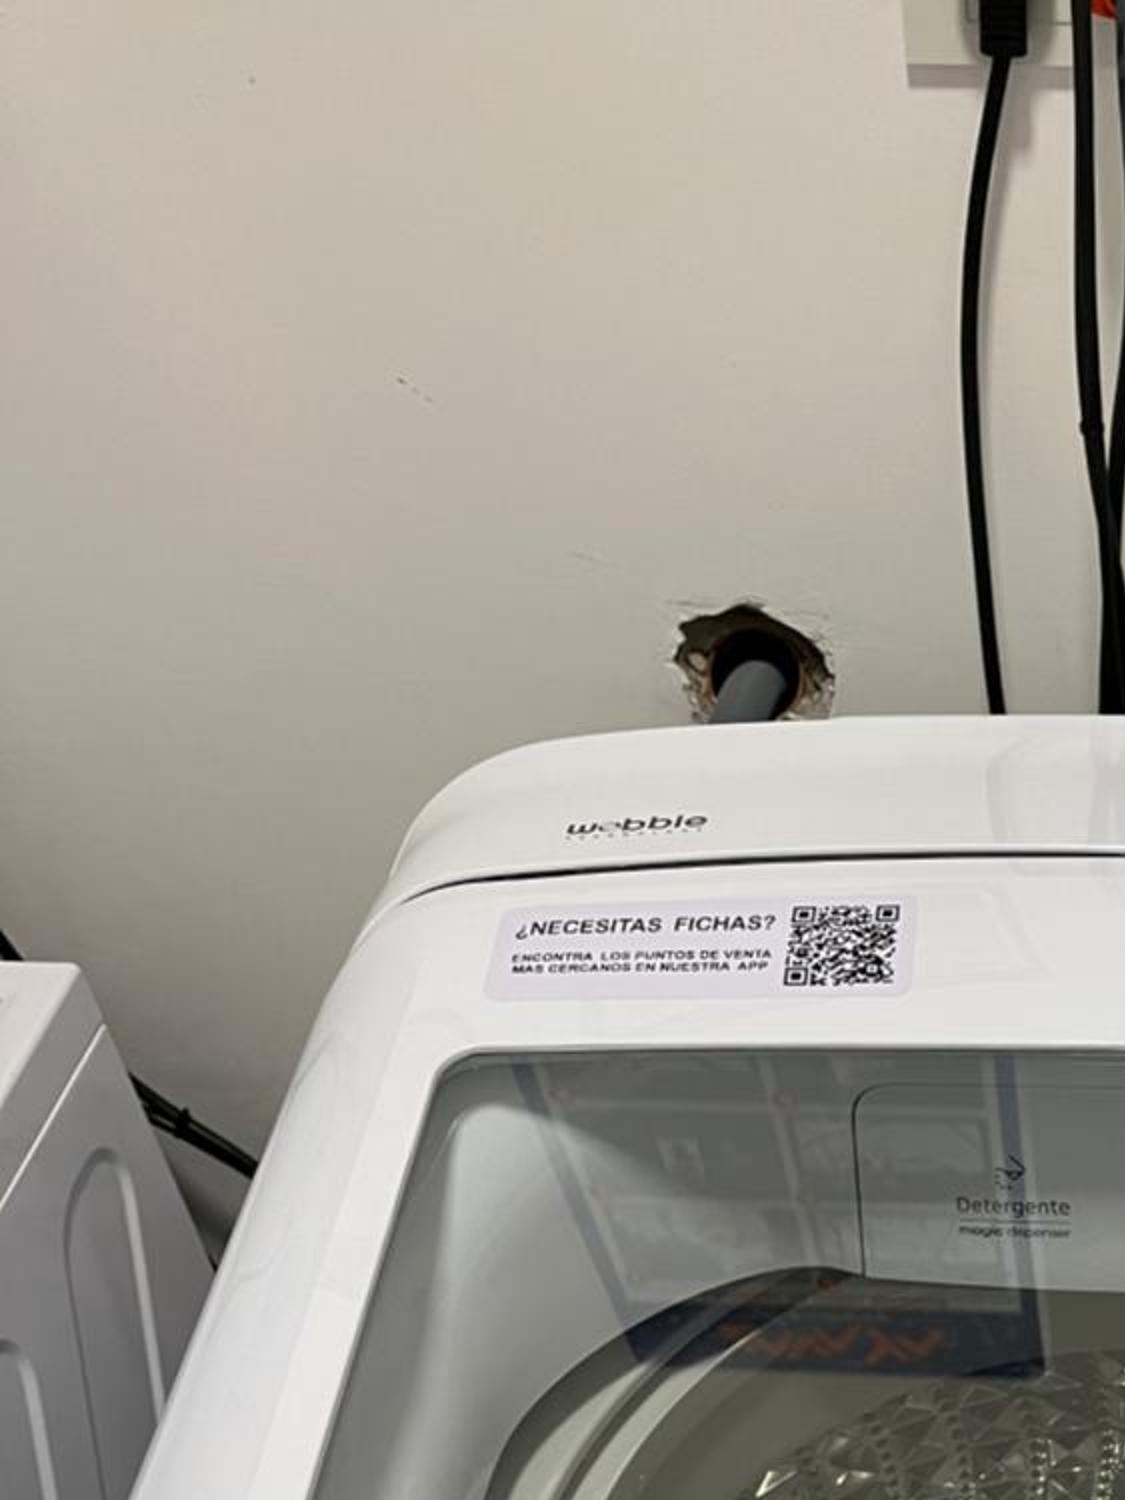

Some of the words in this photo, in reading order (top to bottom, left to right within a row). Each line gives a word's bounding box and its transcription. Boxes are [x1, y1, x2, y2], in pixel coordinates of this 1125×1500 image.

[515, 917, 662, 940] ¿NECESITAS
[674, 915, 776, 932] FICHAS?
[512, 951, 592, 963] ENCONTRA
[601, 951, 631, 961] LOS
[635, 950, 695, 961] PUNTOS
[700, 950, 718, 960] DE
[724, 949, 772, 960] VENTA
[549, 963, 631, 973] CERCANOS
[636, 962, 655, 972] EN
[660, 962, 730, 973] NUESTRA
[737, 961, 769, 971] APP
[956, 1197, 1071, 1219] Detergente
